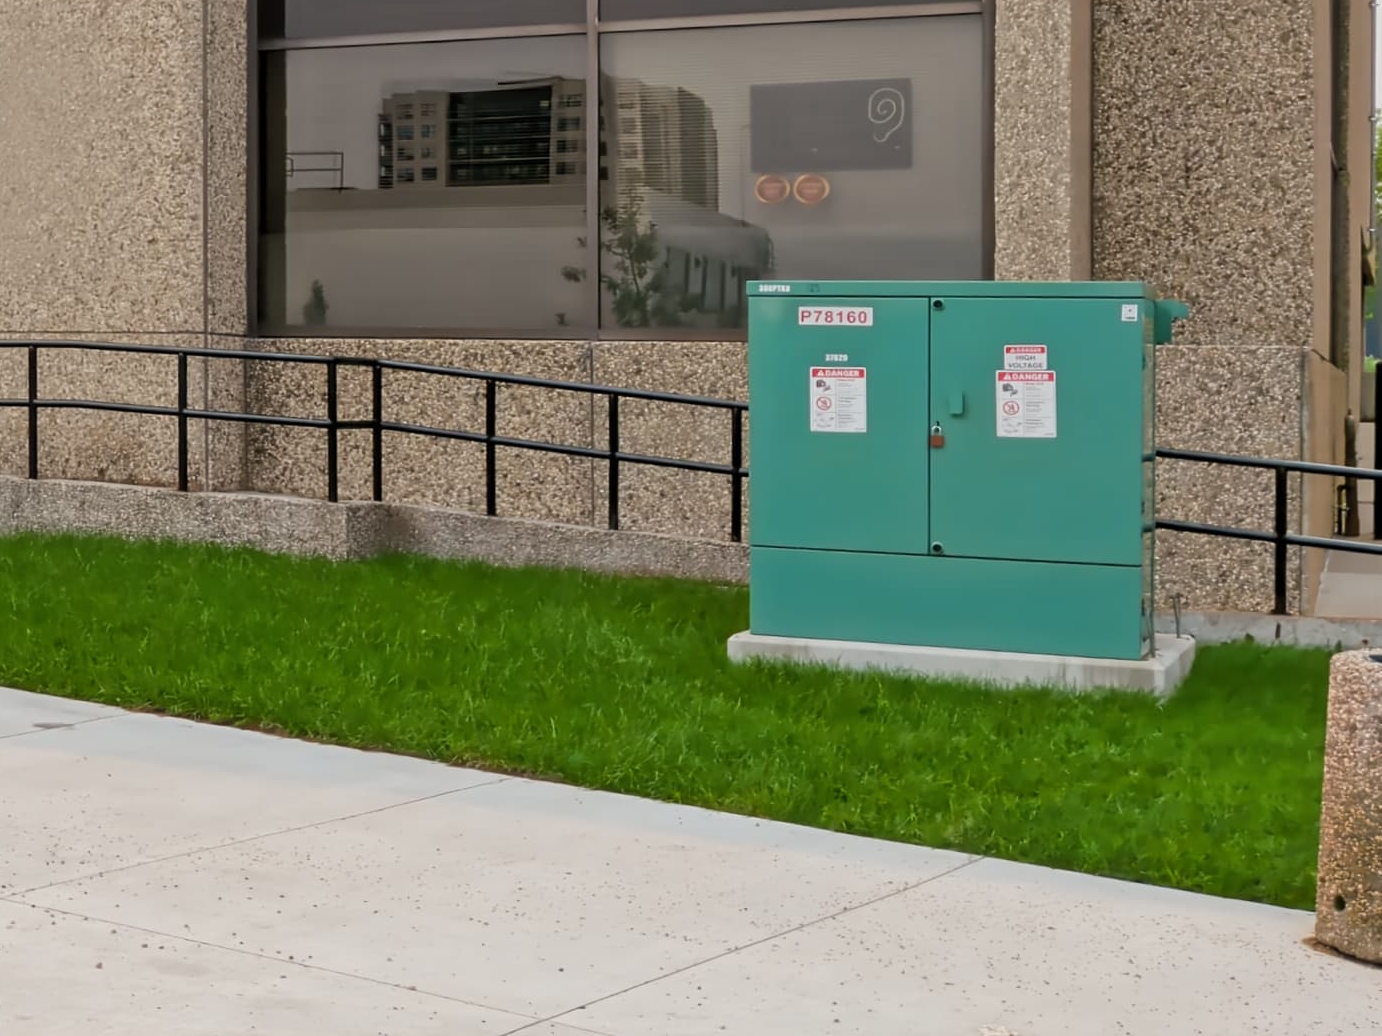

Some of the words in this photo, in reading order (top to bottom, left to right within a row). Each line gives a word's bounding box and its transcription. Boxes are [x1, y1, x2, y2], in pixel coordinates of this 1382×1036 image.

[800, 310, 868, 324] P78160
[825, 369, 860, 377] DANGER
[1012, 373, 1050, 381] DANGER
